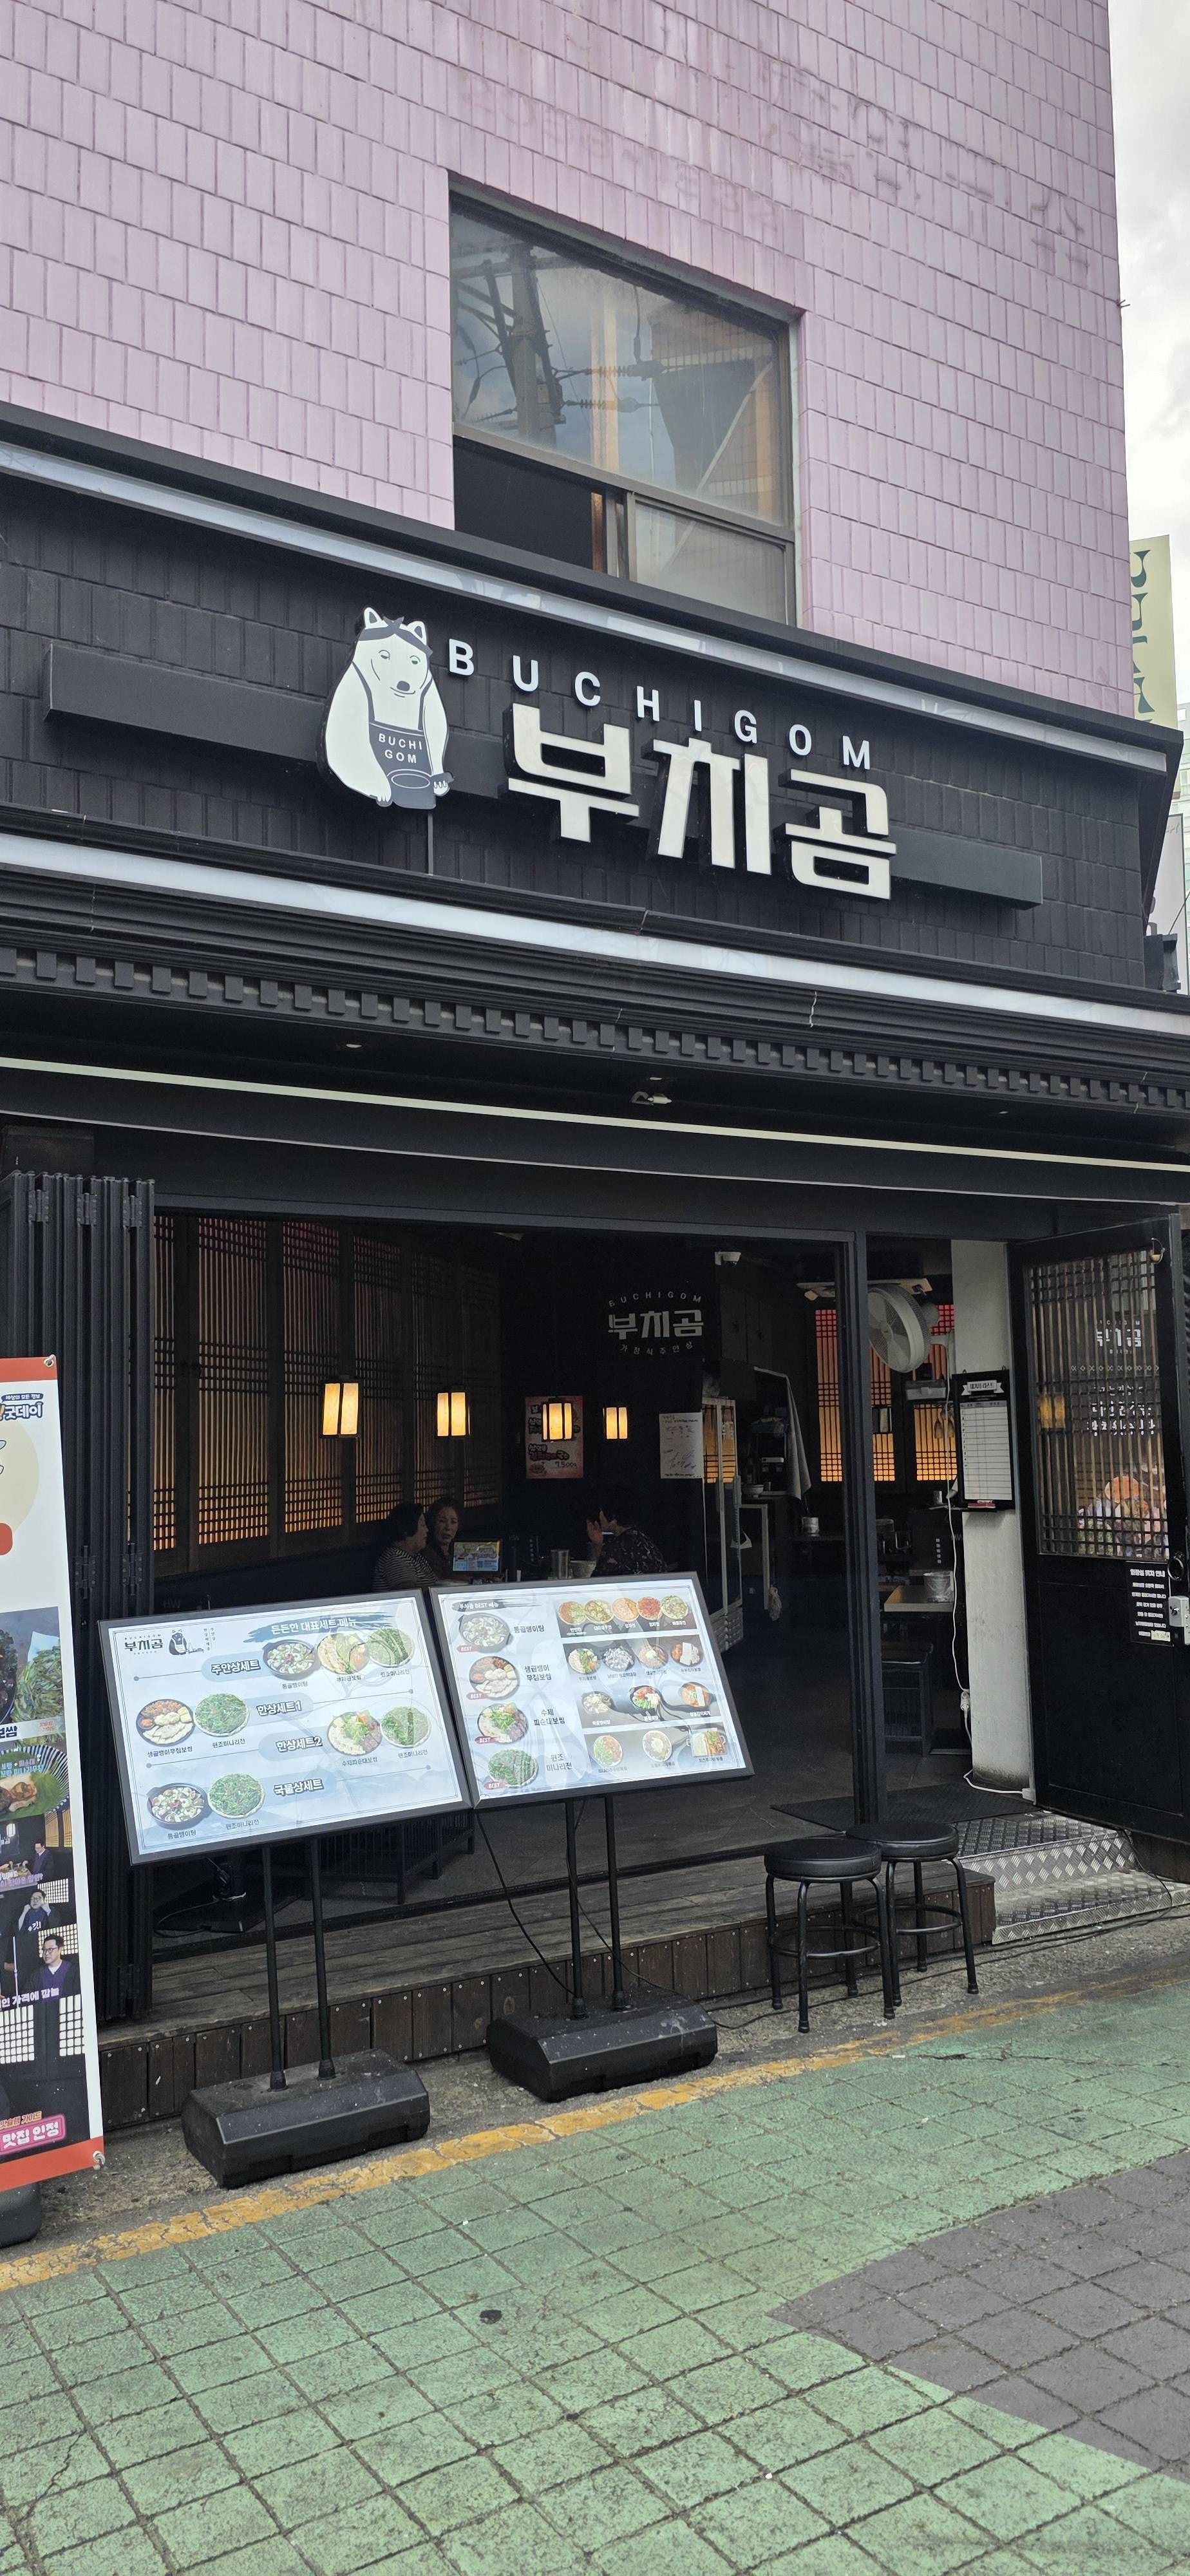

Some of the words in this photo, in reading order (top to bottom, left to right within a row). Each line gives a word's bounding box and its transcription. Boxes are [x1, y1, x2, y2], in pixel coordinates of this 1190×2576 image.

[448, 638, 871, 770] BUCHIGOM
[377, 732, 423, 750] BUCHI
[384, 748, 417, 764] GOM
[507, 702, 896, 900] 부치곰
[608, 1291, 701, 1307] BUCHIGOM
[607, 1309, 704, 1340] 부치곰
[270, 1624, 299, 1634] 든든한
[124, 1638, 164, 1652] 부치곰
[211, 1660, 261, 1674] 주안상세트
[526, 1672, 552, 1682] 무침보쌈
[257, 1700, 302, 1716] 한상세트1
[533, 1717, 565, 1727] 피순대보쌈
[211, 1738, 246, 1748] 원조미나리전
[275, 1736, 323, 1752] 한상세트2
[397, 1749, 428, 1759] 원조미나리전
[551, 1754, 565, 1762] 원조
[546, 1763, 572, 1772] 미나리전
[274, 1779, 324, 1795] 국물상세트
[225, 1819, 260, 1830] 원조미나리전
[0, 1997, 10, 2008] 인
[21, 2110, 42, 2125] 가이드
[2, 2128, 30, 2149] 맛집
[32, 2121, 59, 2141] 인정
